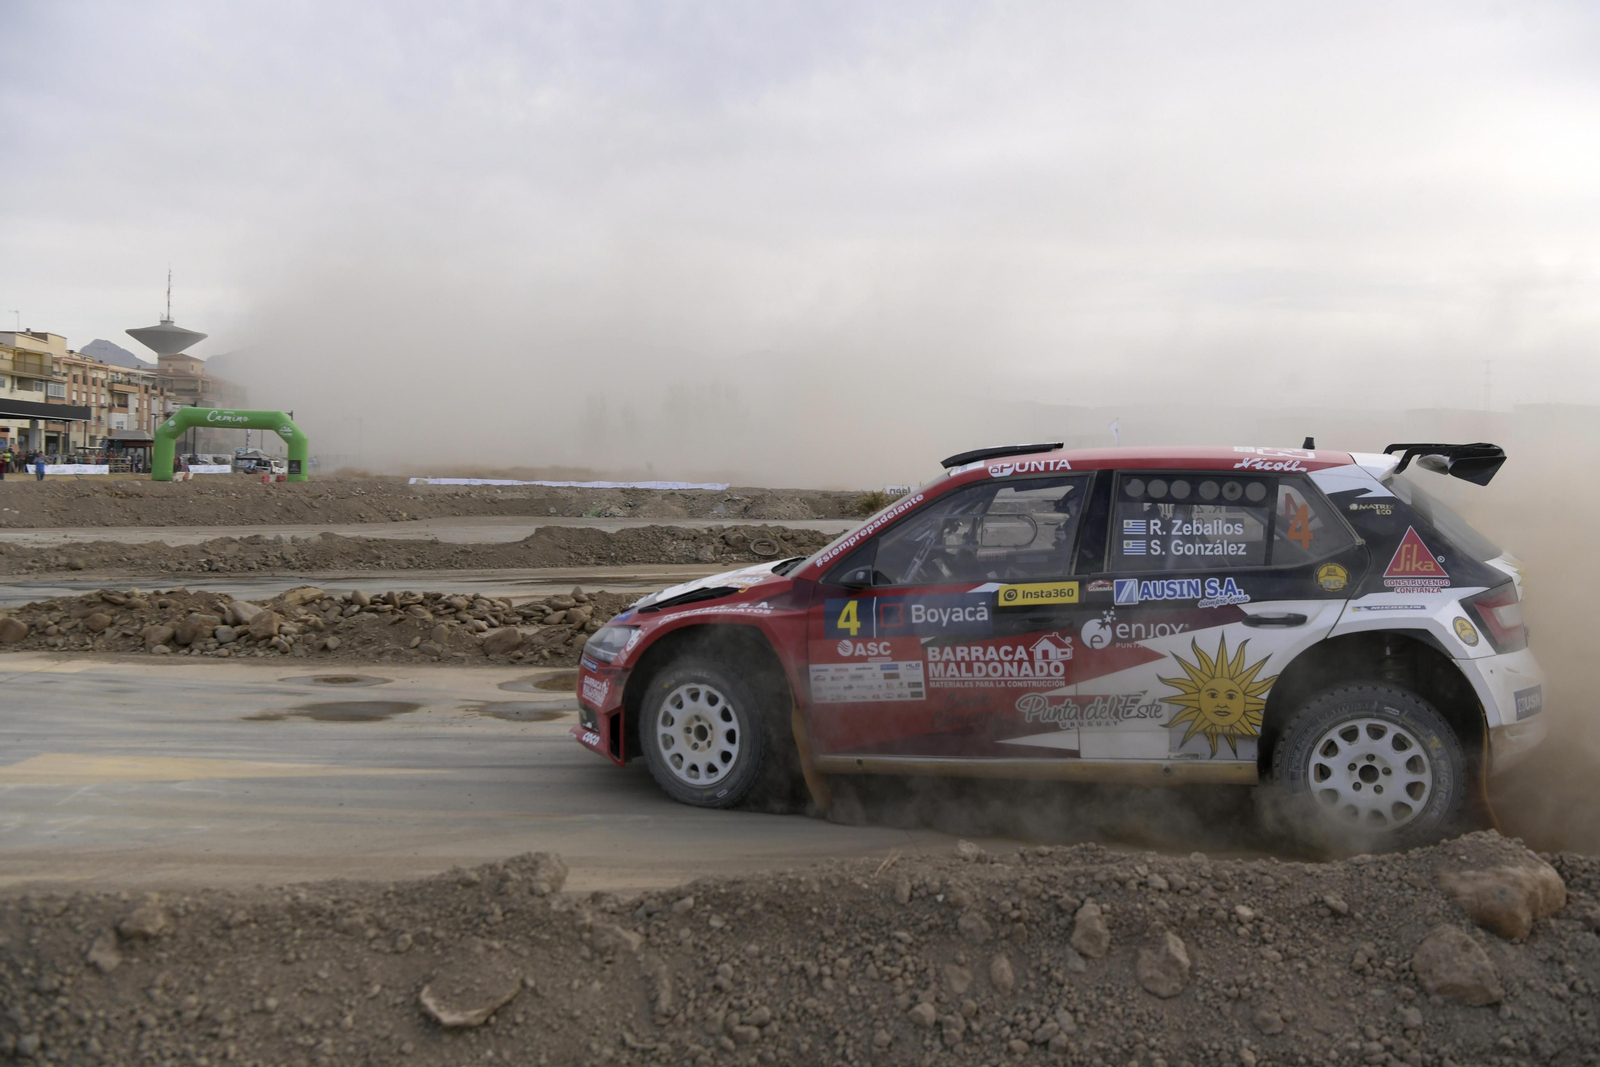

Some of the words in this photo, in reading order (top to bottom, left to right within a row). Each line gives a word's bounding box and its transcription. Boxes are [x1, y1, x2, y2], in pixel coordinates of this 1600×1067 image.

[206, 410, 250, 423] Camino
[1233, 457, 1308, 472] Nicoll
[1149, 520, 1167, 536] R.
[1171, 519, 1244, 536] Zeballos
[1287, 503, 1314, 549] 4
[1149, 539, 1166, 556] S.
[1171, 539, 1247, 556] González
[1392, 543, 1436, 572] Sika
[1140, 579, 1202, 601] AUSIN
[1205, 577, 1245, 597] S.A.
[1384, 579, 1450, 587] CONSTRUYENDO
[1021, 587, 1074, 600] Insta360
[1197, 596, 1229, 608] siempre
[1229, 593, 1251, 605] cerca
[836, 599, 861, 636] 4
[855, 641, 891, 656] ASC
[927, 645, 1028, 661] BARRACA
[928, 661, 1065, 678] MALDONADO
[929, 680, 970, 688] MATERIALES
[971, 680, 994, 688] PARA
[1007, 679, 1066, 688] CONSTRUCCIÓN
[1015, 692, 1086, 723] Punta
[1085, 695, 1118, 721] del
[1118, 690, 1165, 721] Este
